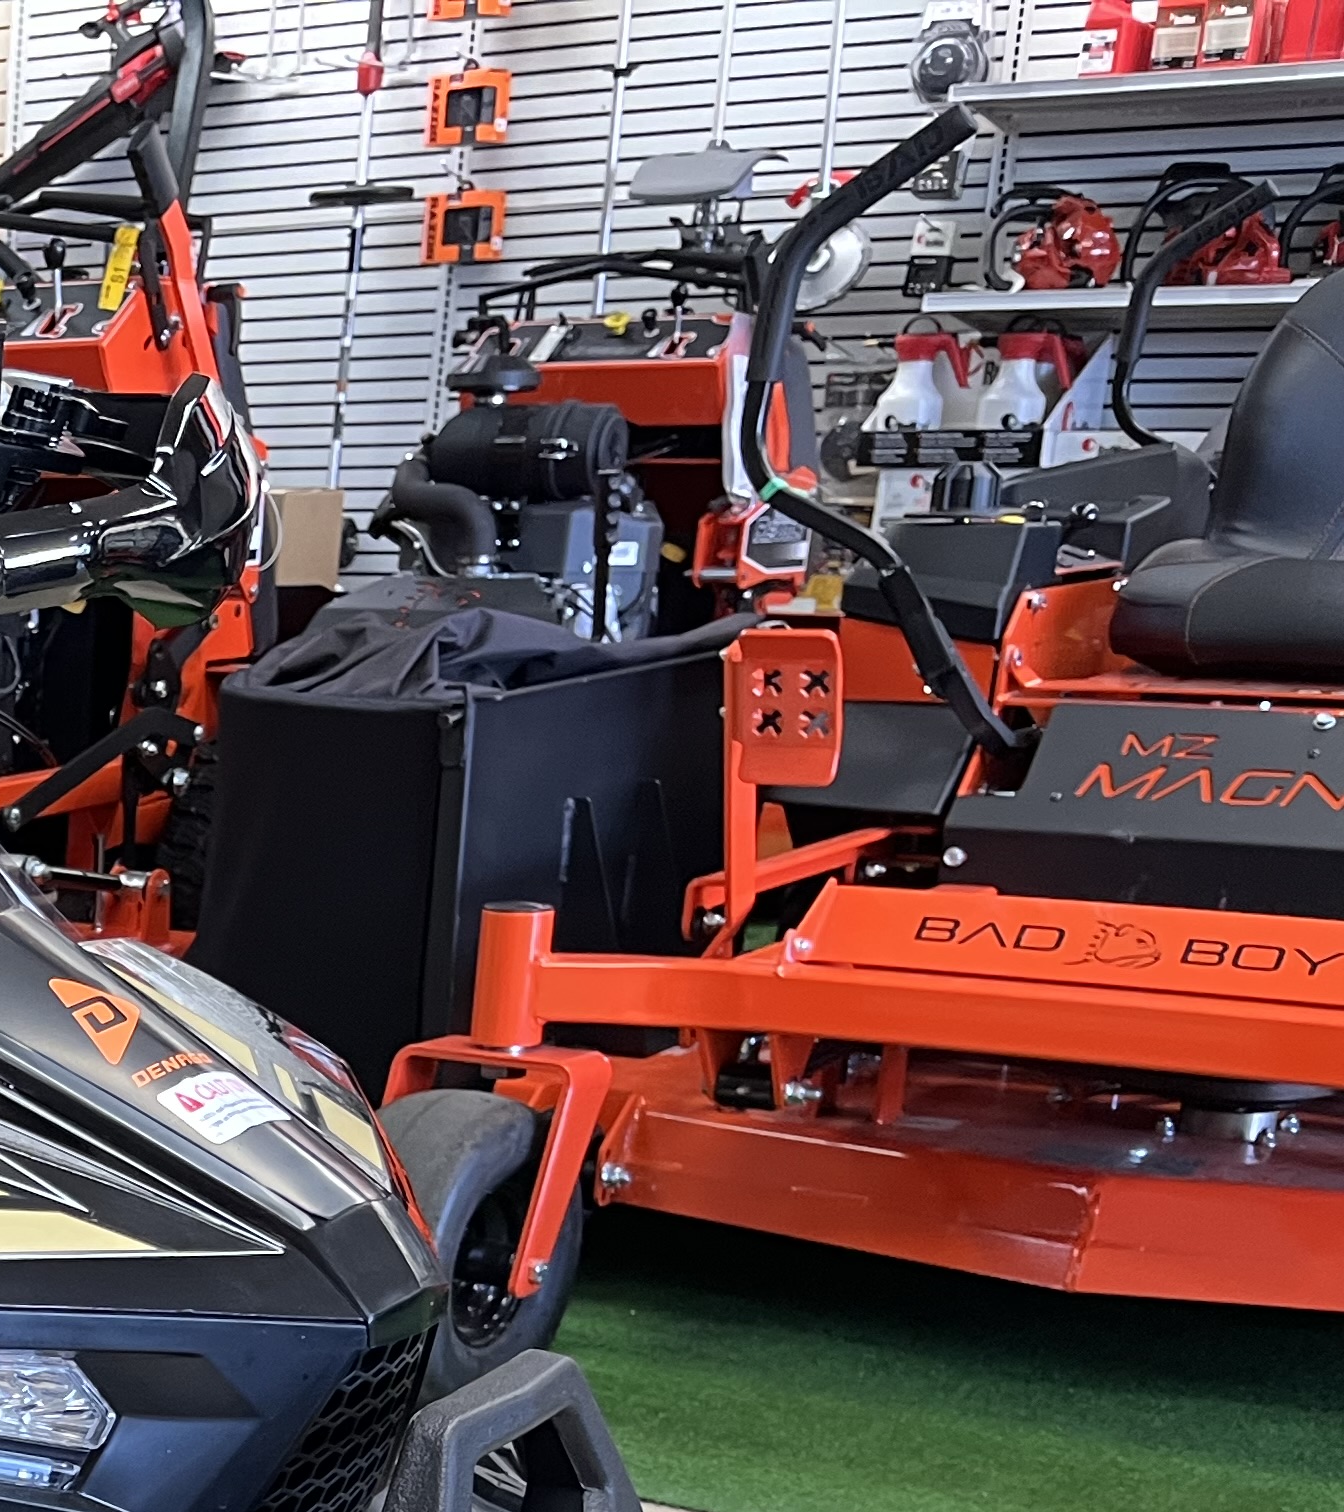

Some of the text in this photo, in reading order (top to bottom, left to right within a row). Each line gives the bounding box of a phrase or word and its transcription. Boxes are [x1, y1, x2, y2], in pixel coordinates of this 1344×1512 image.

[1120, 731, 1220, 760] MZ
[914, 916, 1344, 976] BAD BOY
[131, 1051, 215, 1089] DENAGO
